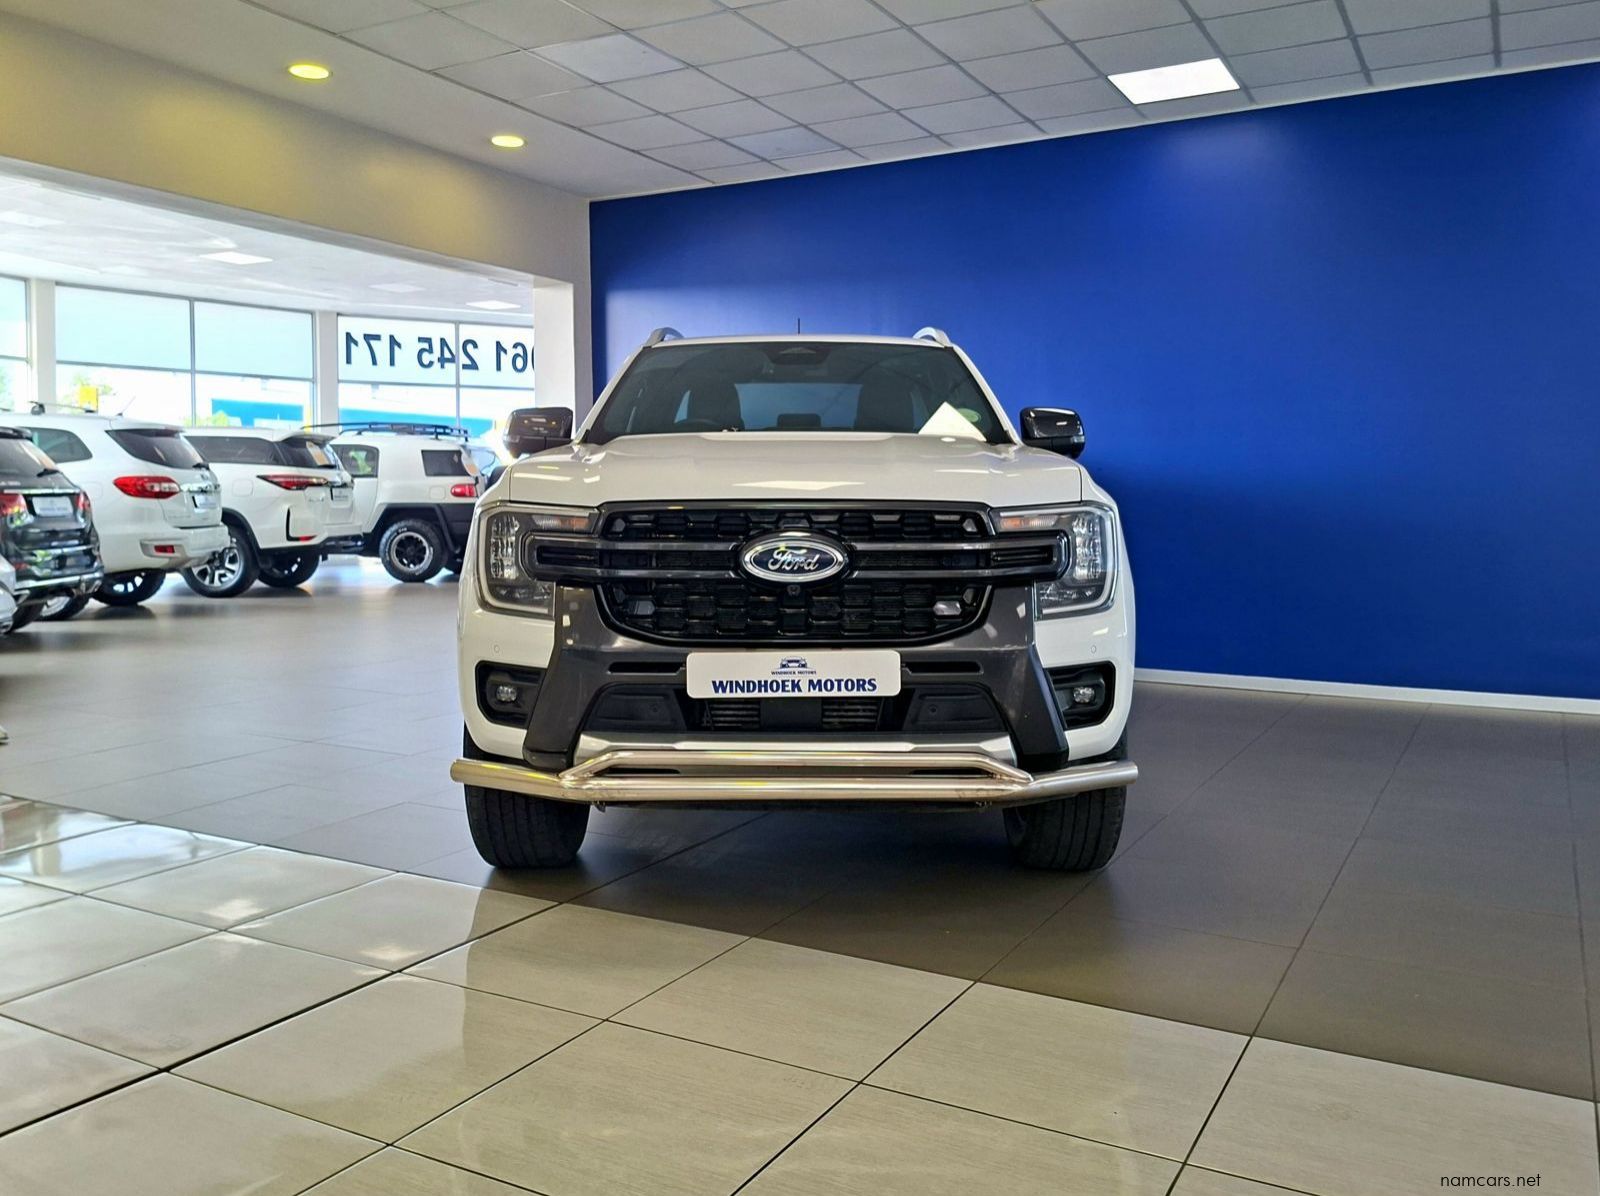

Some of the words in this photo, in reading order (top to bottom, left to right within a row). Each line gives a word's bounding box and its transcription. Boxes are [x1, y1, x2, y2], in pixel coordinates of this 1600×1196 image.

[767, 548, 820, 571] Ford
[711, 679, 803, 694] WINDHOEK
[808, 677, 878, 692] MOTORS
